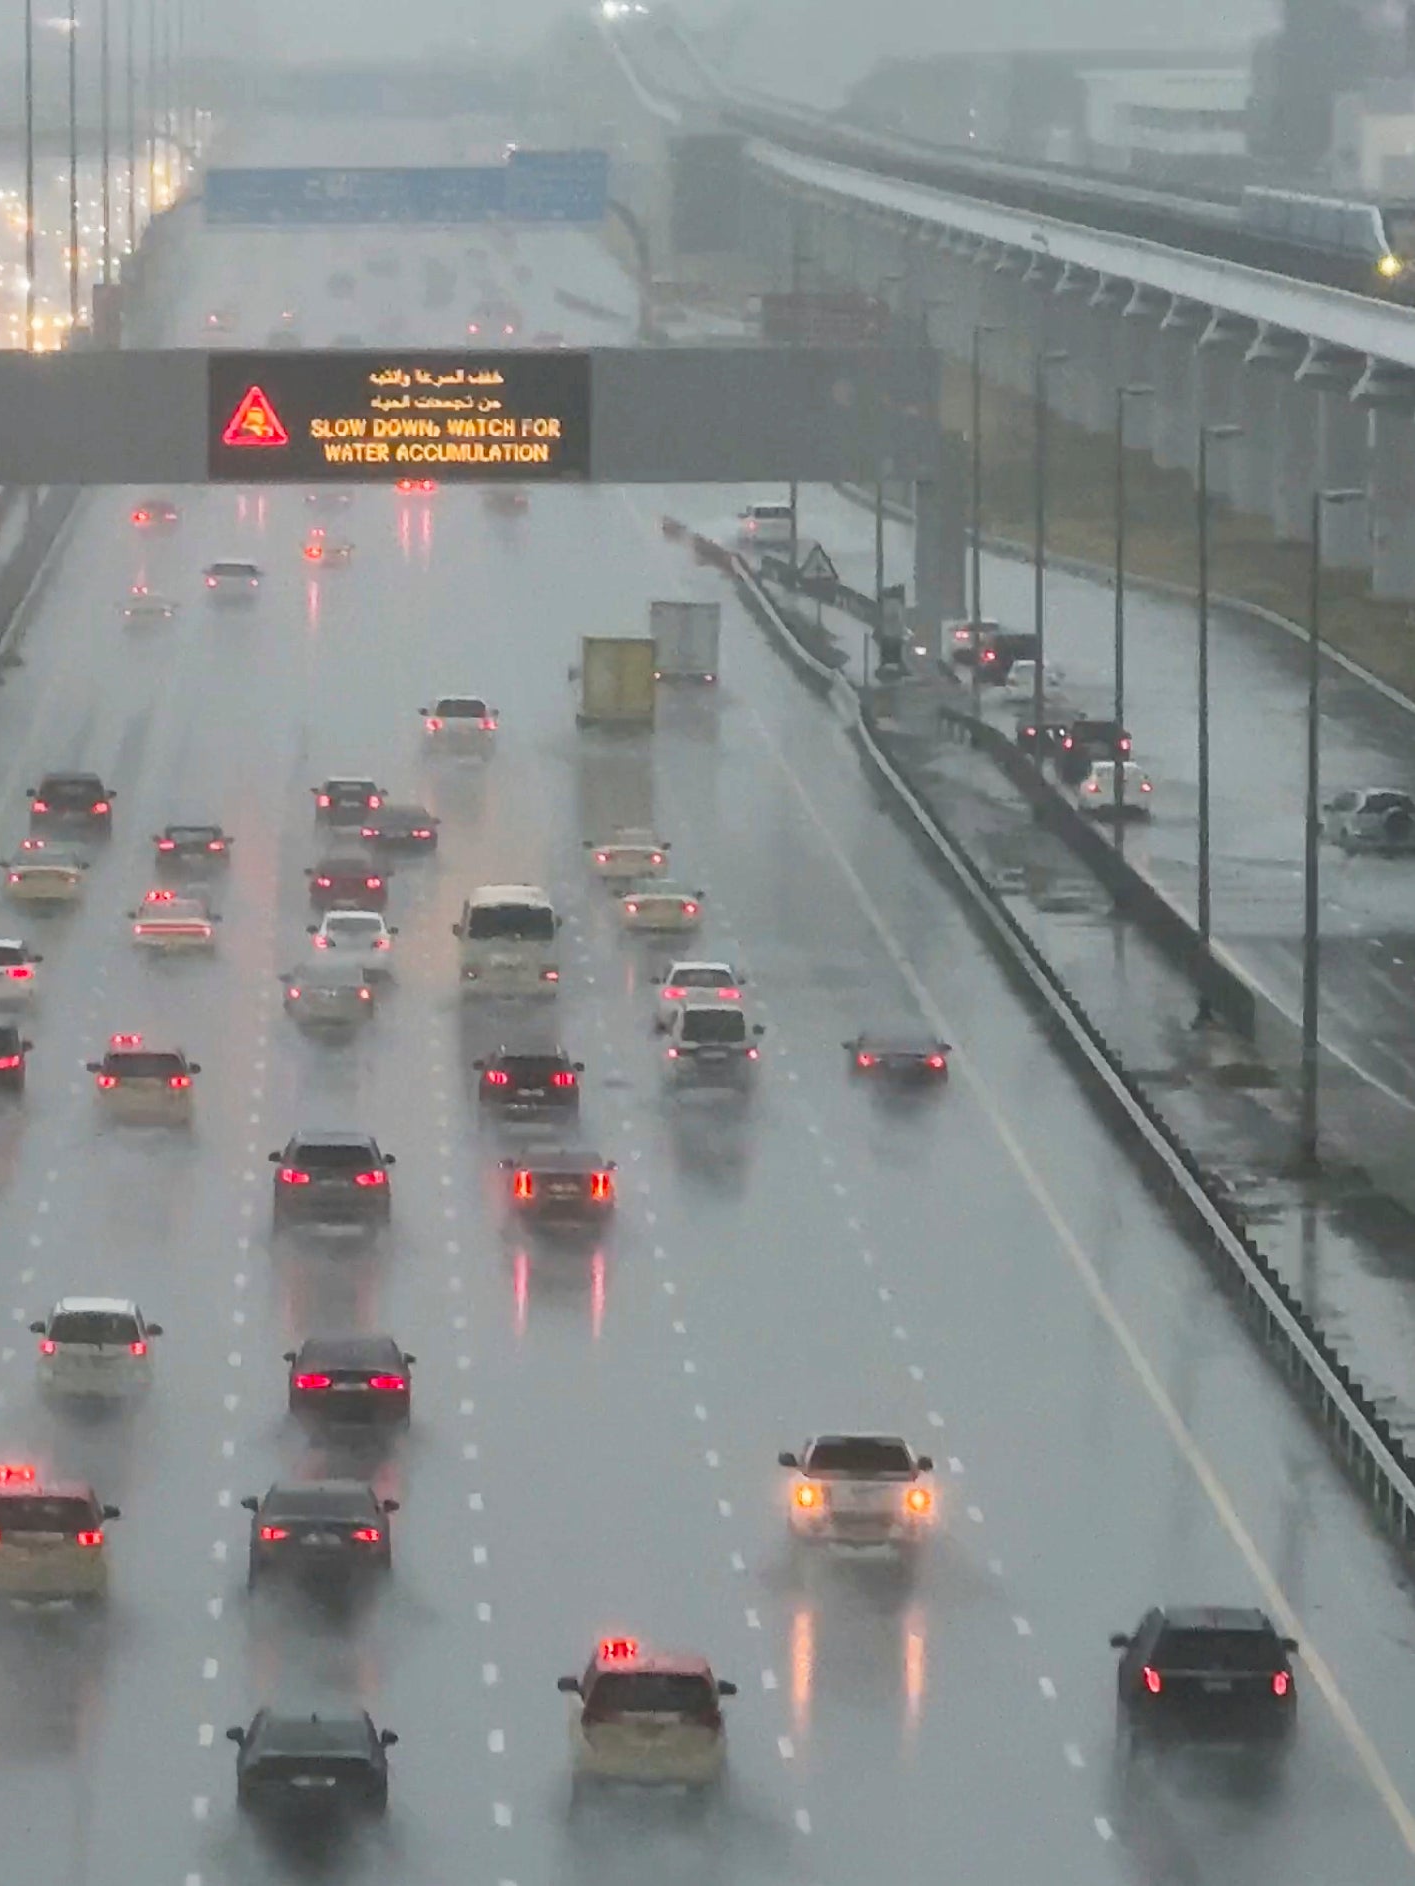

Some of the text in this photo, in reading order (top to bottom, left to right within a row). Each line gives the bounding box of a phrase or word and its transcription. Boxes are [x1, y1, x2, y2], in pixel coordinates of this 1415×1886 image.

[311, 419, 366, 438] SLOW
[447, 419, 515, 438] WATCH
[521, 419, 561, 438] FOR
[324, 444, 549, 463] WATER ACCUMULATION
